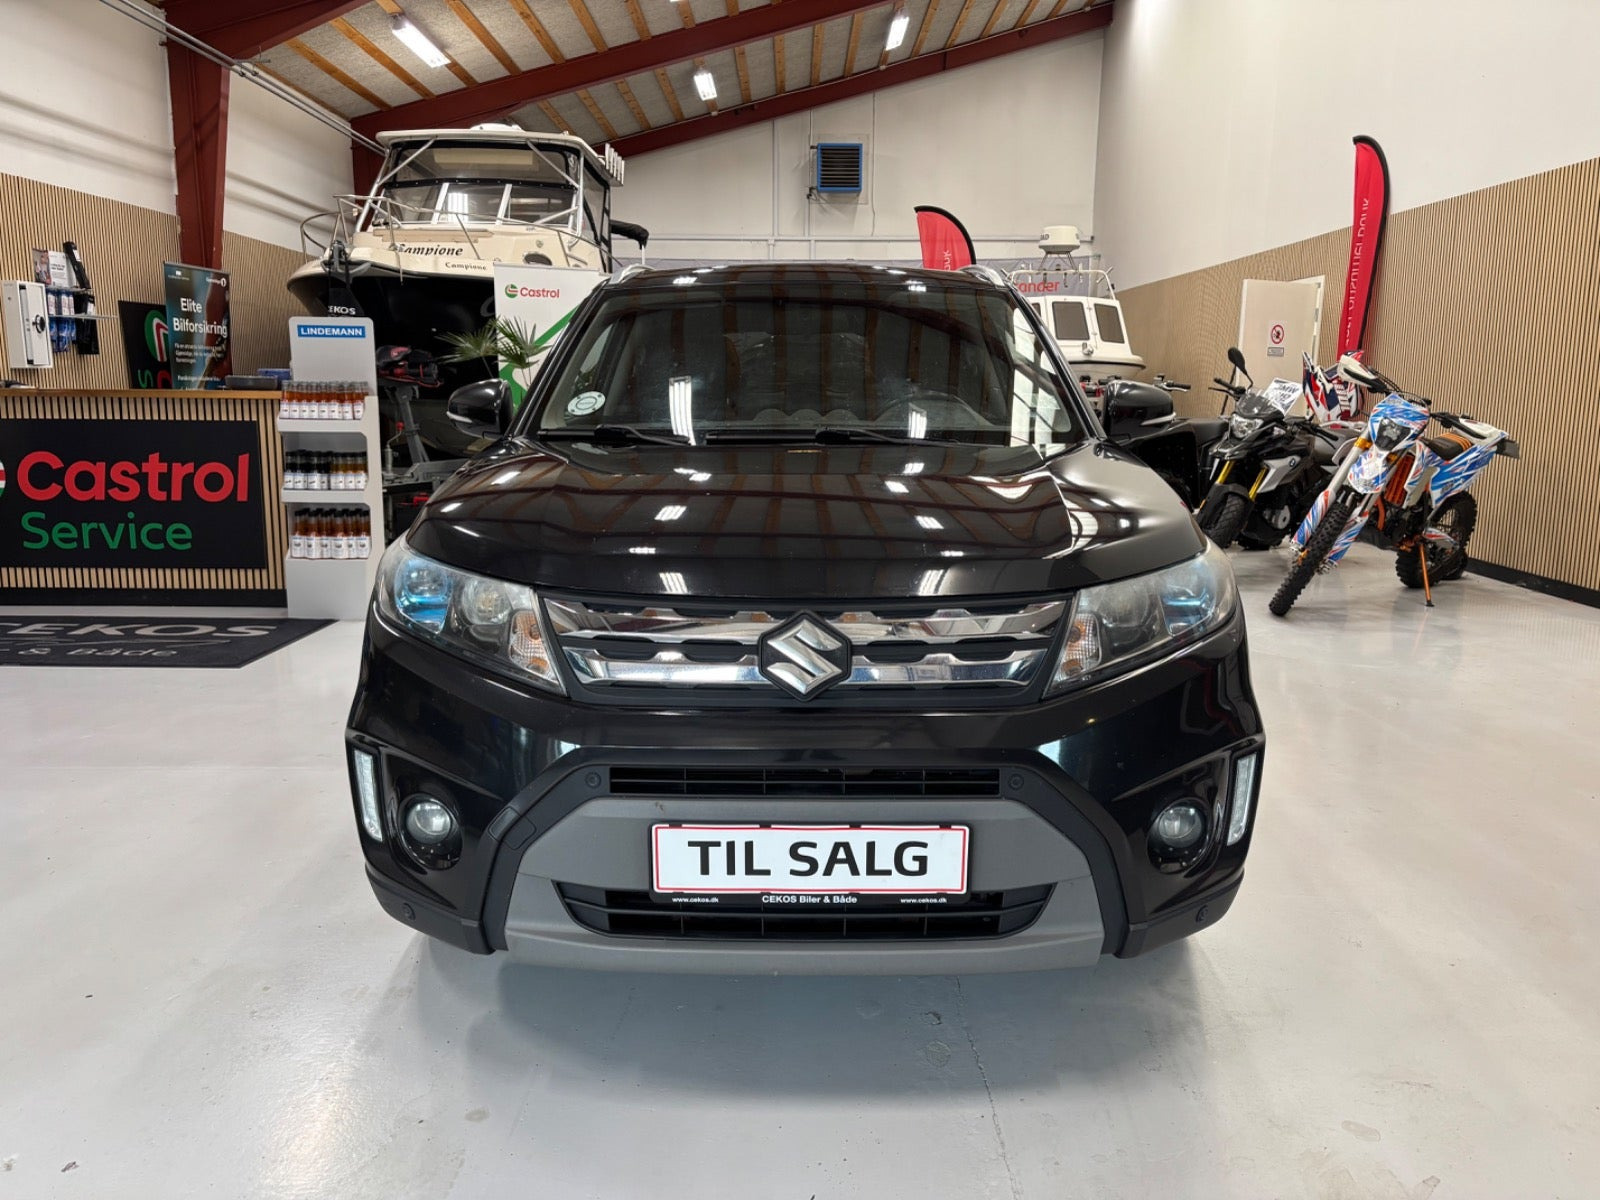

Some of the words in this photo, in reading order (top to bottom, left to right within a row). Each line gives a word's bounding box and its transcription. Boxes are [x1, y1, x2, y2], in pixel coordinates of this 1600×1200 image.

[520, 287, 560, 298] Castrol
[1014, 281, 1060, 293] ander
[180, 297, 202, 313] Elite
[328, 305, 356, 315] EKOS
[173, 317, 228, 338] Bilforsikring
[300, 328, 362, 336] LINDEMANN
[17, 451, 250, 502] Castrol
[21, 511, 193, 550] Service
[0, 623, 277, 637] EKOS
[687, 840, 772, 876] TIL
[788, 841, 929, 877] SALG
[762, 895, 797, 904] CEKOS
[800, 895, 821, 904] Biler
[823, 895, 831, 904] &
[833, 895, 858, 904] Både
